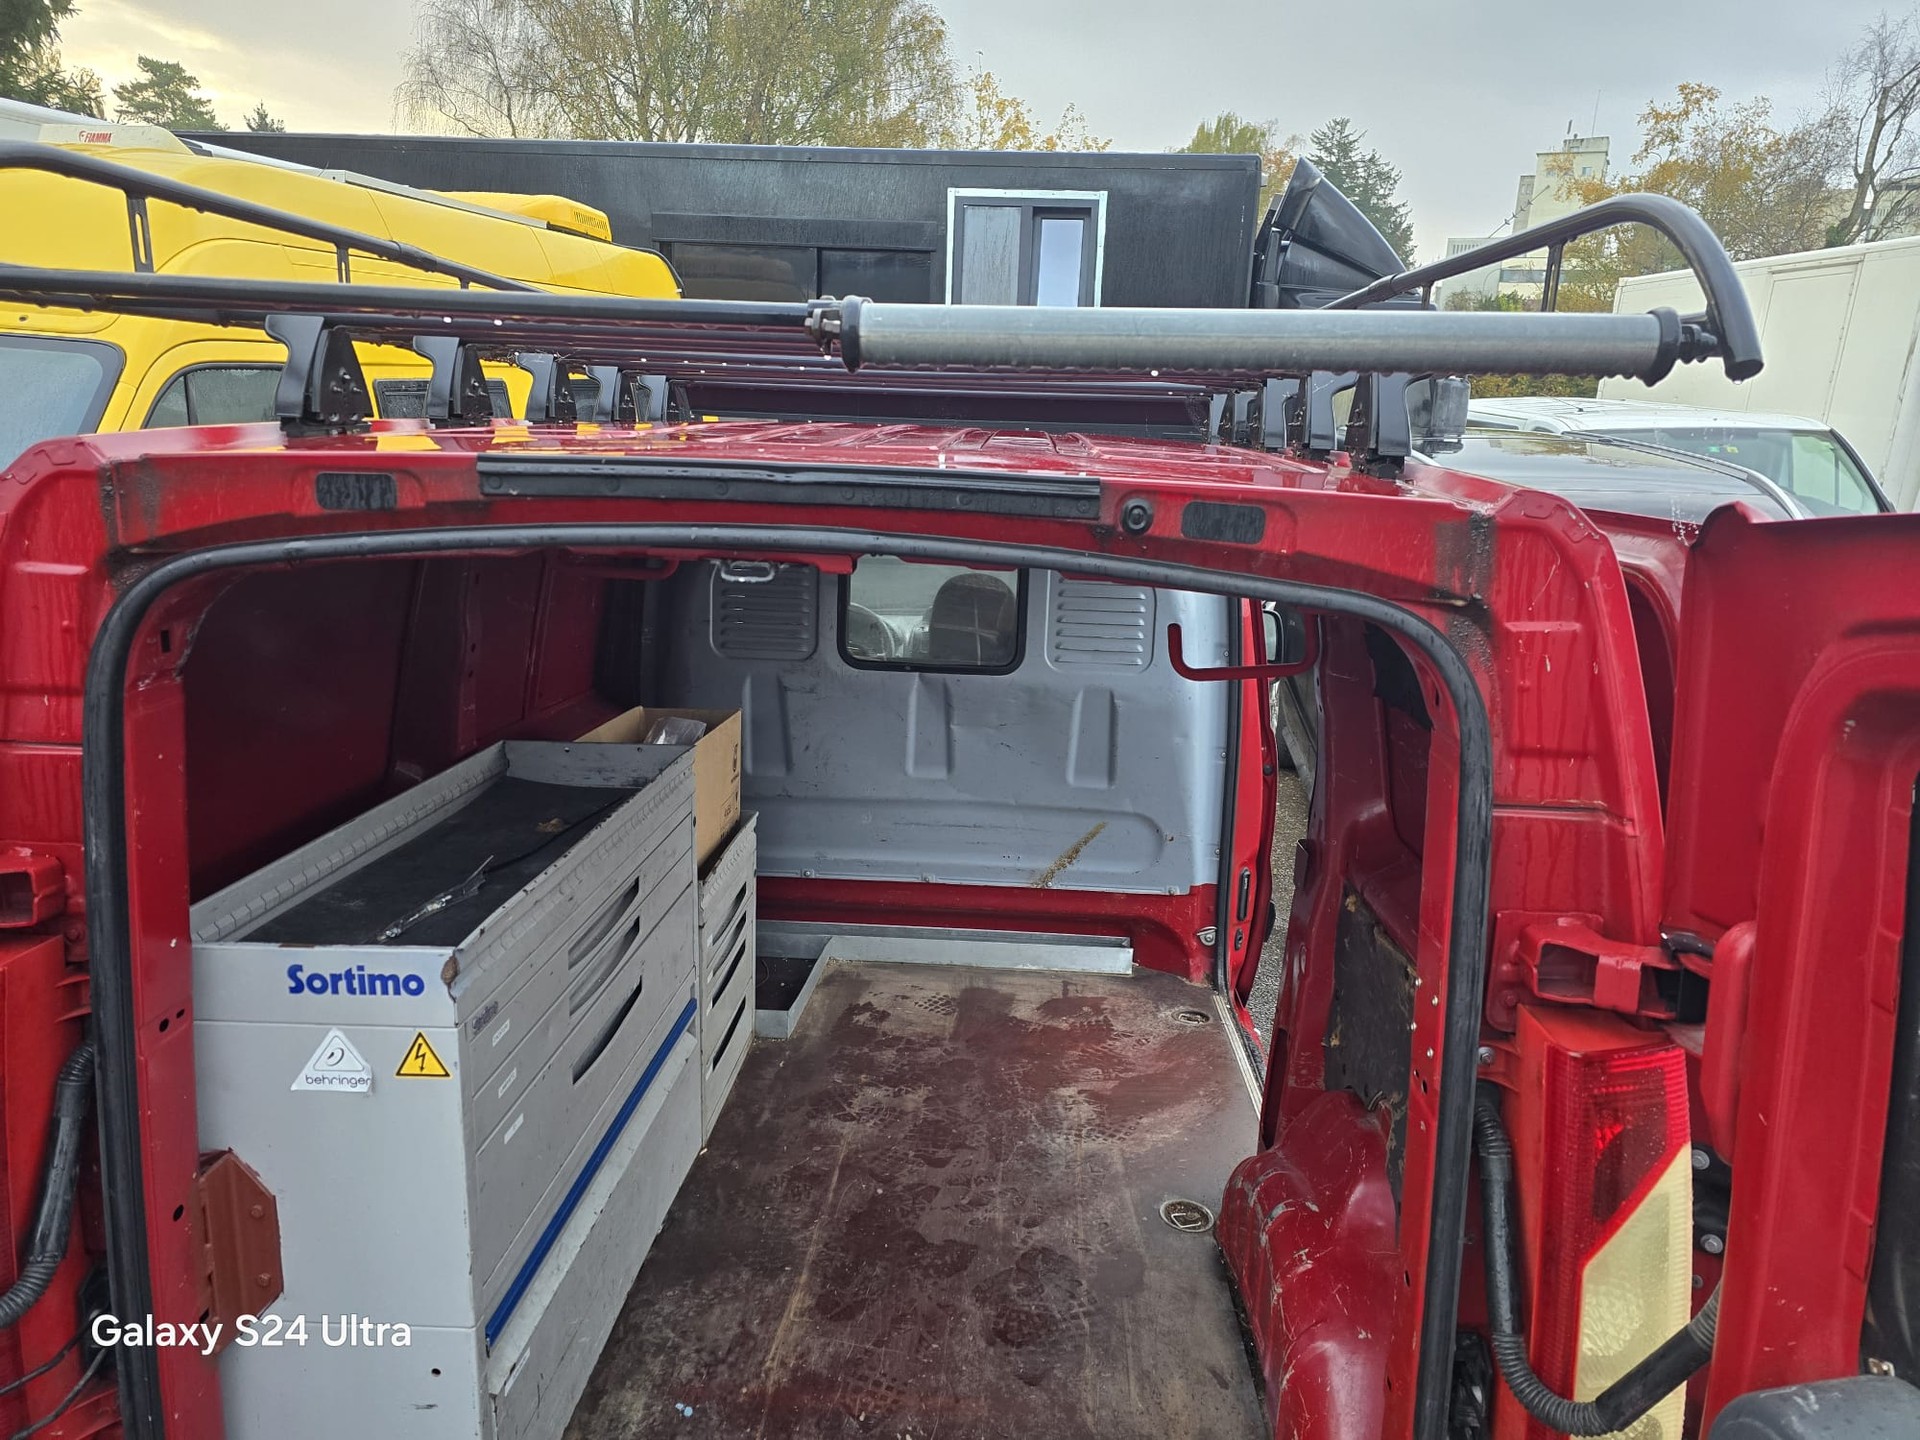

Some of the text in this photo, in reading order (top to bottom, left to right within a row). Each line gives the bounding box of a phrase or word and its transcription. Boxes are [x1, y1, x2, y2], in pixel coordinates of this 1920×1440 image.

[84, 132, 112, 143] FIAMMA
[287, 964, 425, 997] Sortimo
[305, 1074, 371, 1088] behringer
